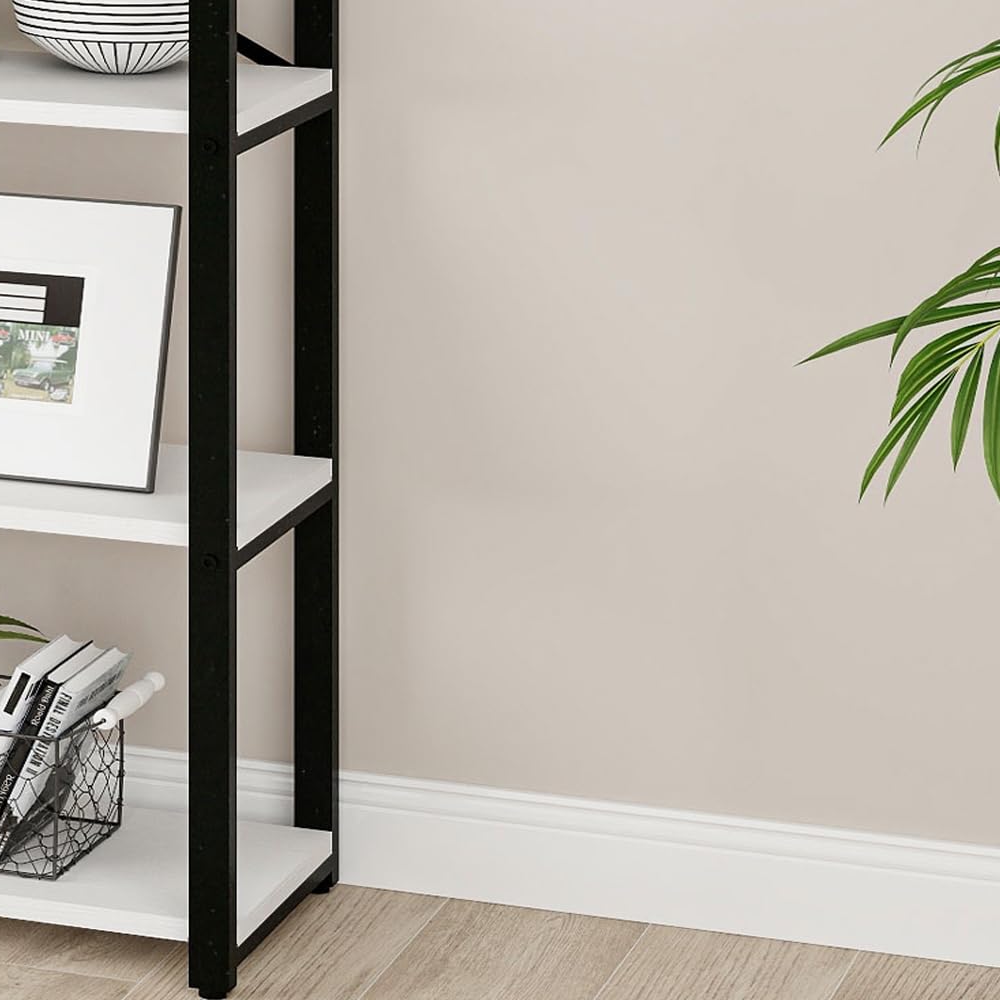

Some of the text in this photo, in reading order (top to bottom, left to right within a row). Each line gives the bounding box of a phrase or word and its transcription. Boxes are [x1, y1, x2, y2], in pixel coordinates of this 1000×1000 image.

[18, 329, 51, 341] MINI
[29, 684, 55, 726] Roald Dahl
[53, 691, 72, 716] FINAL
